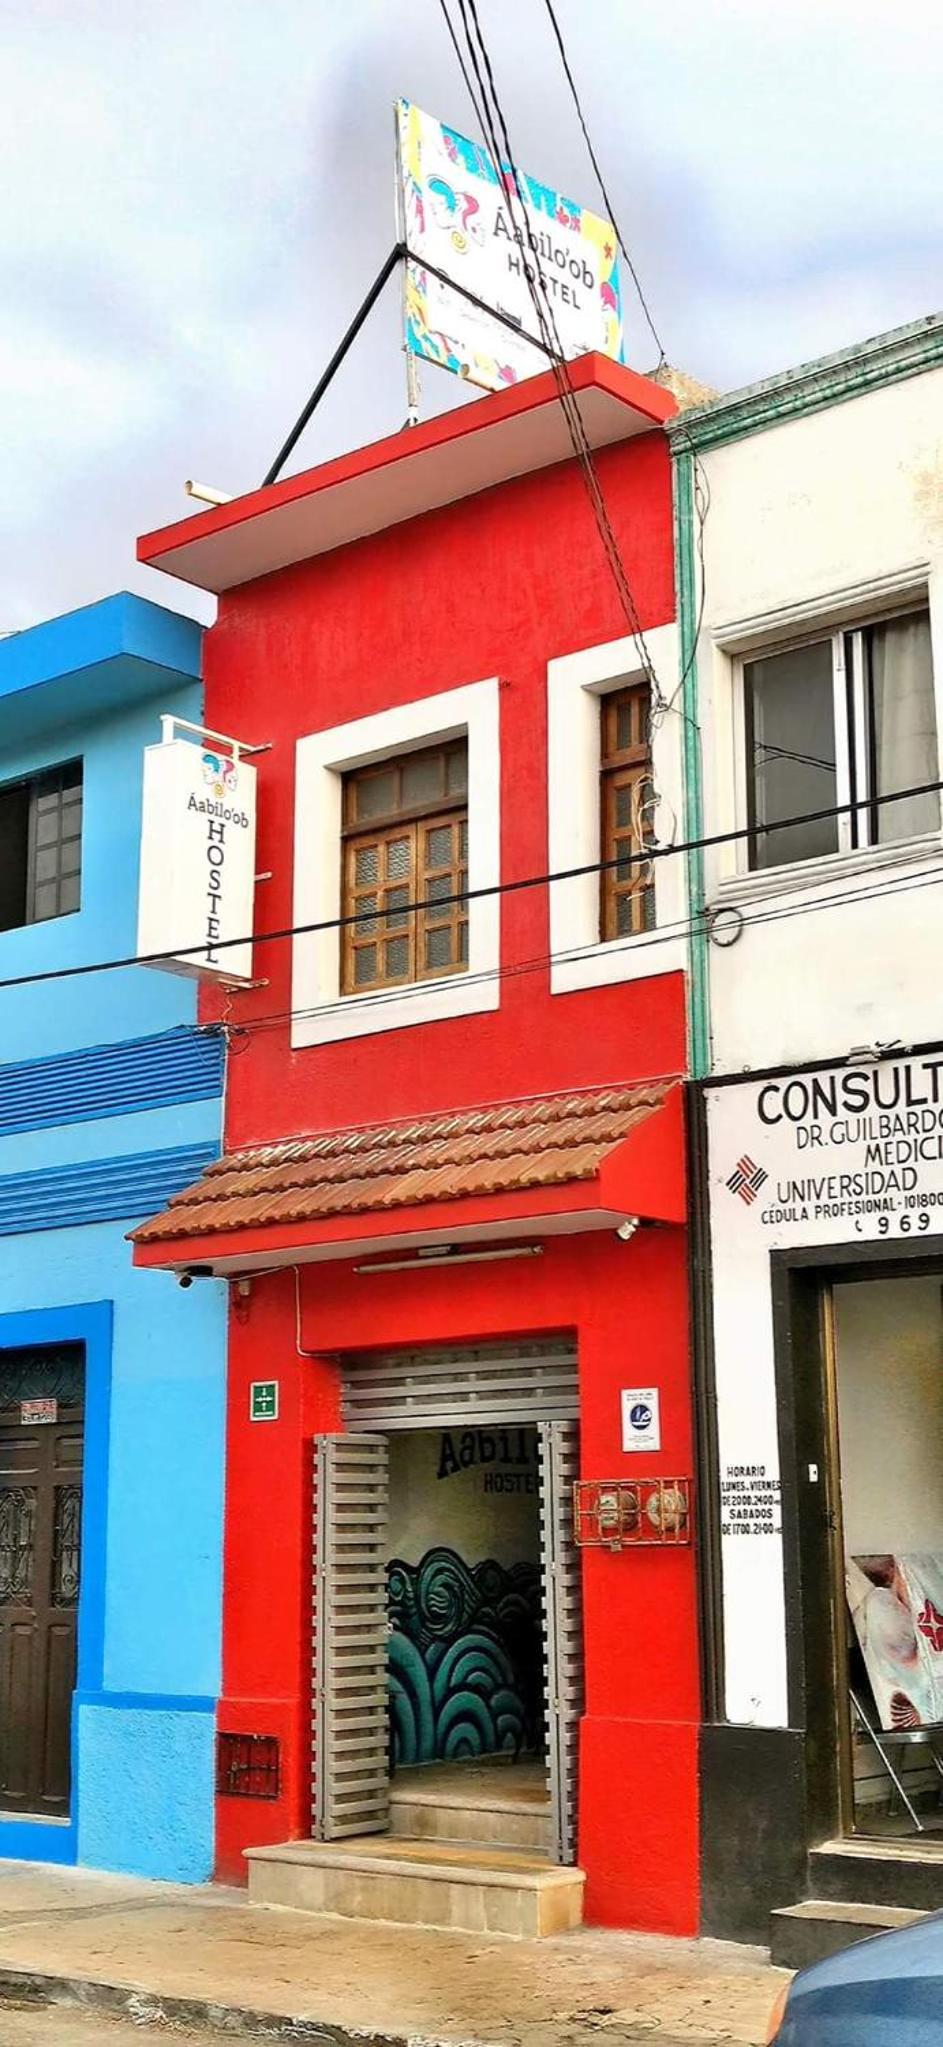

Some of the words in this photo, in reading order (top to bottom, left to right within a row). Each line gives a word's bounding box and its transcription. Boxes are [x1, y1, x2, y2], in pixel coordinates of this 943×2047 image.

[508, 253, 581, 310] HOSTEL
[205, 819, 225, 964] HOSTEL
[757, 1061, 943, 1124] CONSULT
[864, 1135, 943, 1168] MEDICI
[777, 1167, 917, 1204] UNIVERSIDAD
[726, 1466, 766, 1478] HORARIO
[729, 1508, 773, 1519] SABADOS
